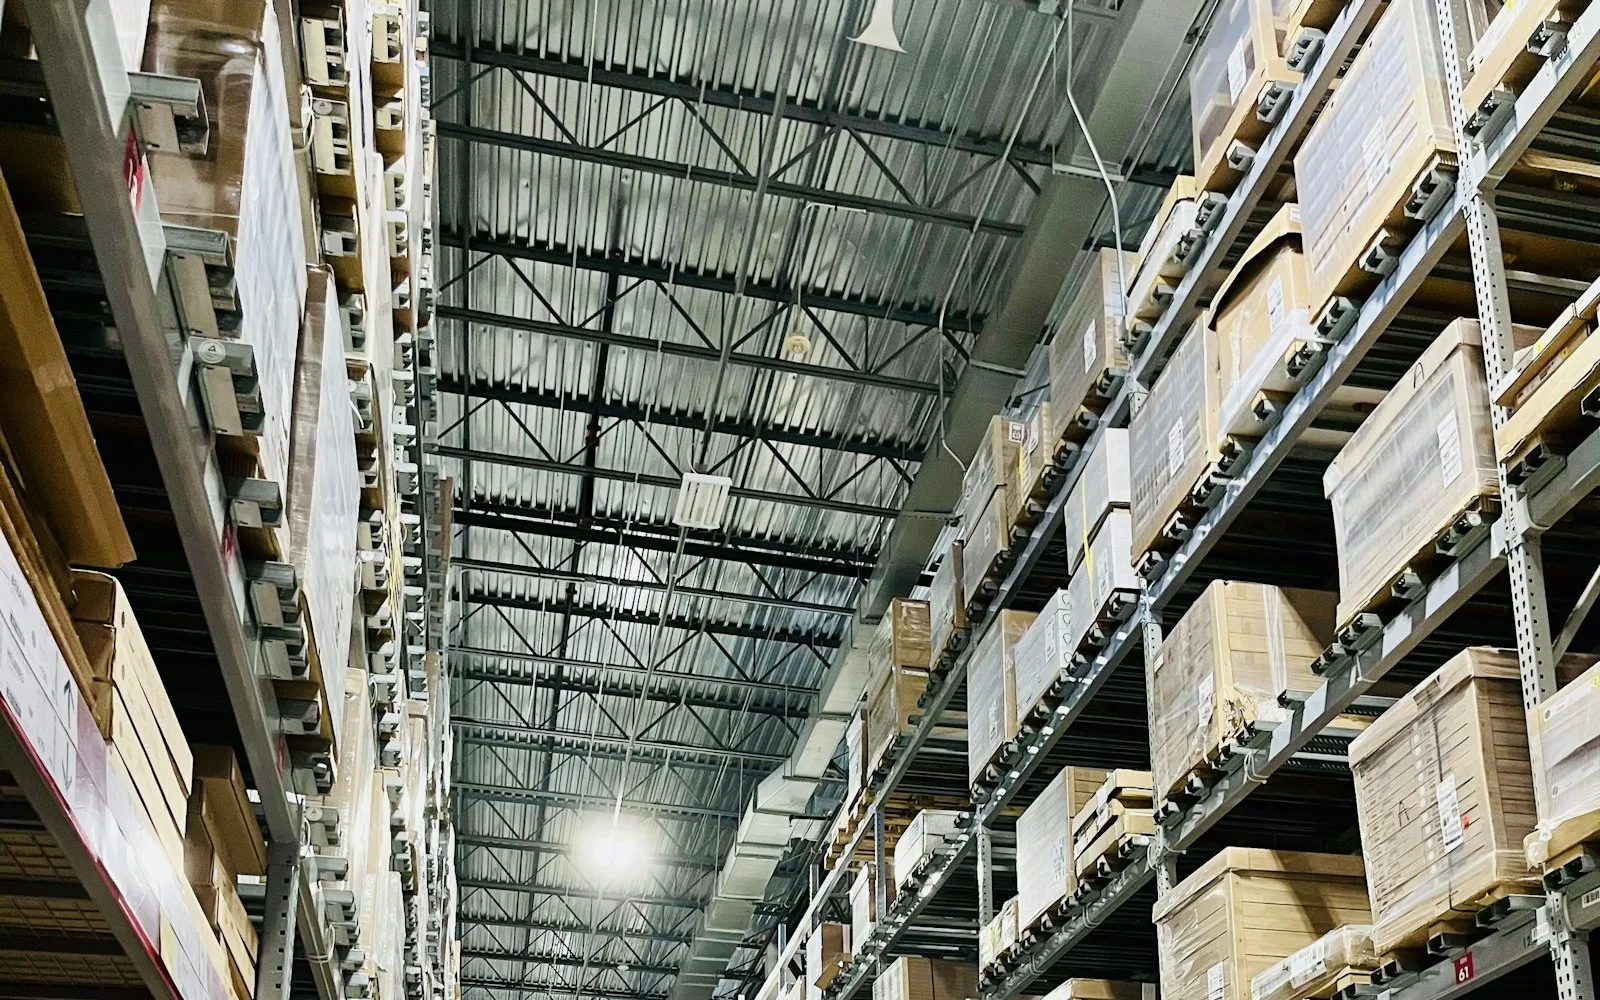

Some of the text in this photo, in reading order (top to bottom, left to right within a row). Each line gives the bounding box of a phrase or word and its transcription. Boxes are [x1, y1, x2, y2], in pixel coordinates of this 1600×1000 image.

[1413, 362, 1425, 389] A
[1397, 800, 1417, 828] A
[1458, 965, 1469, 982] 61
